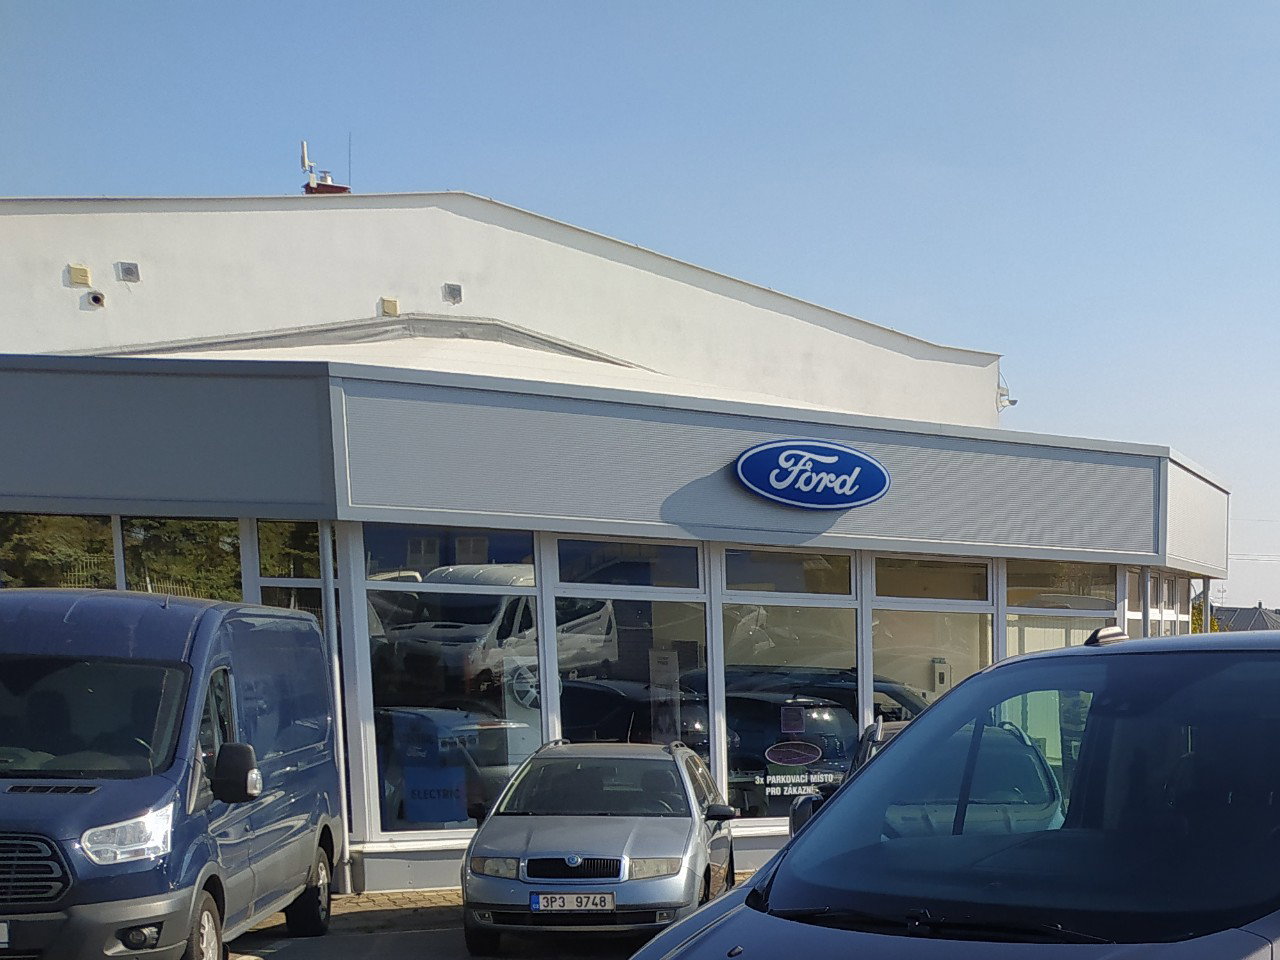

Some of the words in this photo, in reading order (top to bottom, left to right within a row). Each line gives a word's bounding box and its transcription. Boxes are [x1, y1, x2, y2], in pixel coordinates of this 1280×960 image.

[769, 450, 861, 495] Ford
[755, 776, 764, 784] 3x
[766, 773, 808, 784] PARKOVACÍ
[810, 772, 833, 783] MÍSTO
[766, 787, 781, 795] PRO
[783, 784, 816, 795] ZÁKAZNÍ
[542, 896, 566, 908] 3P3
[575, 896, 607, 908] 9748
